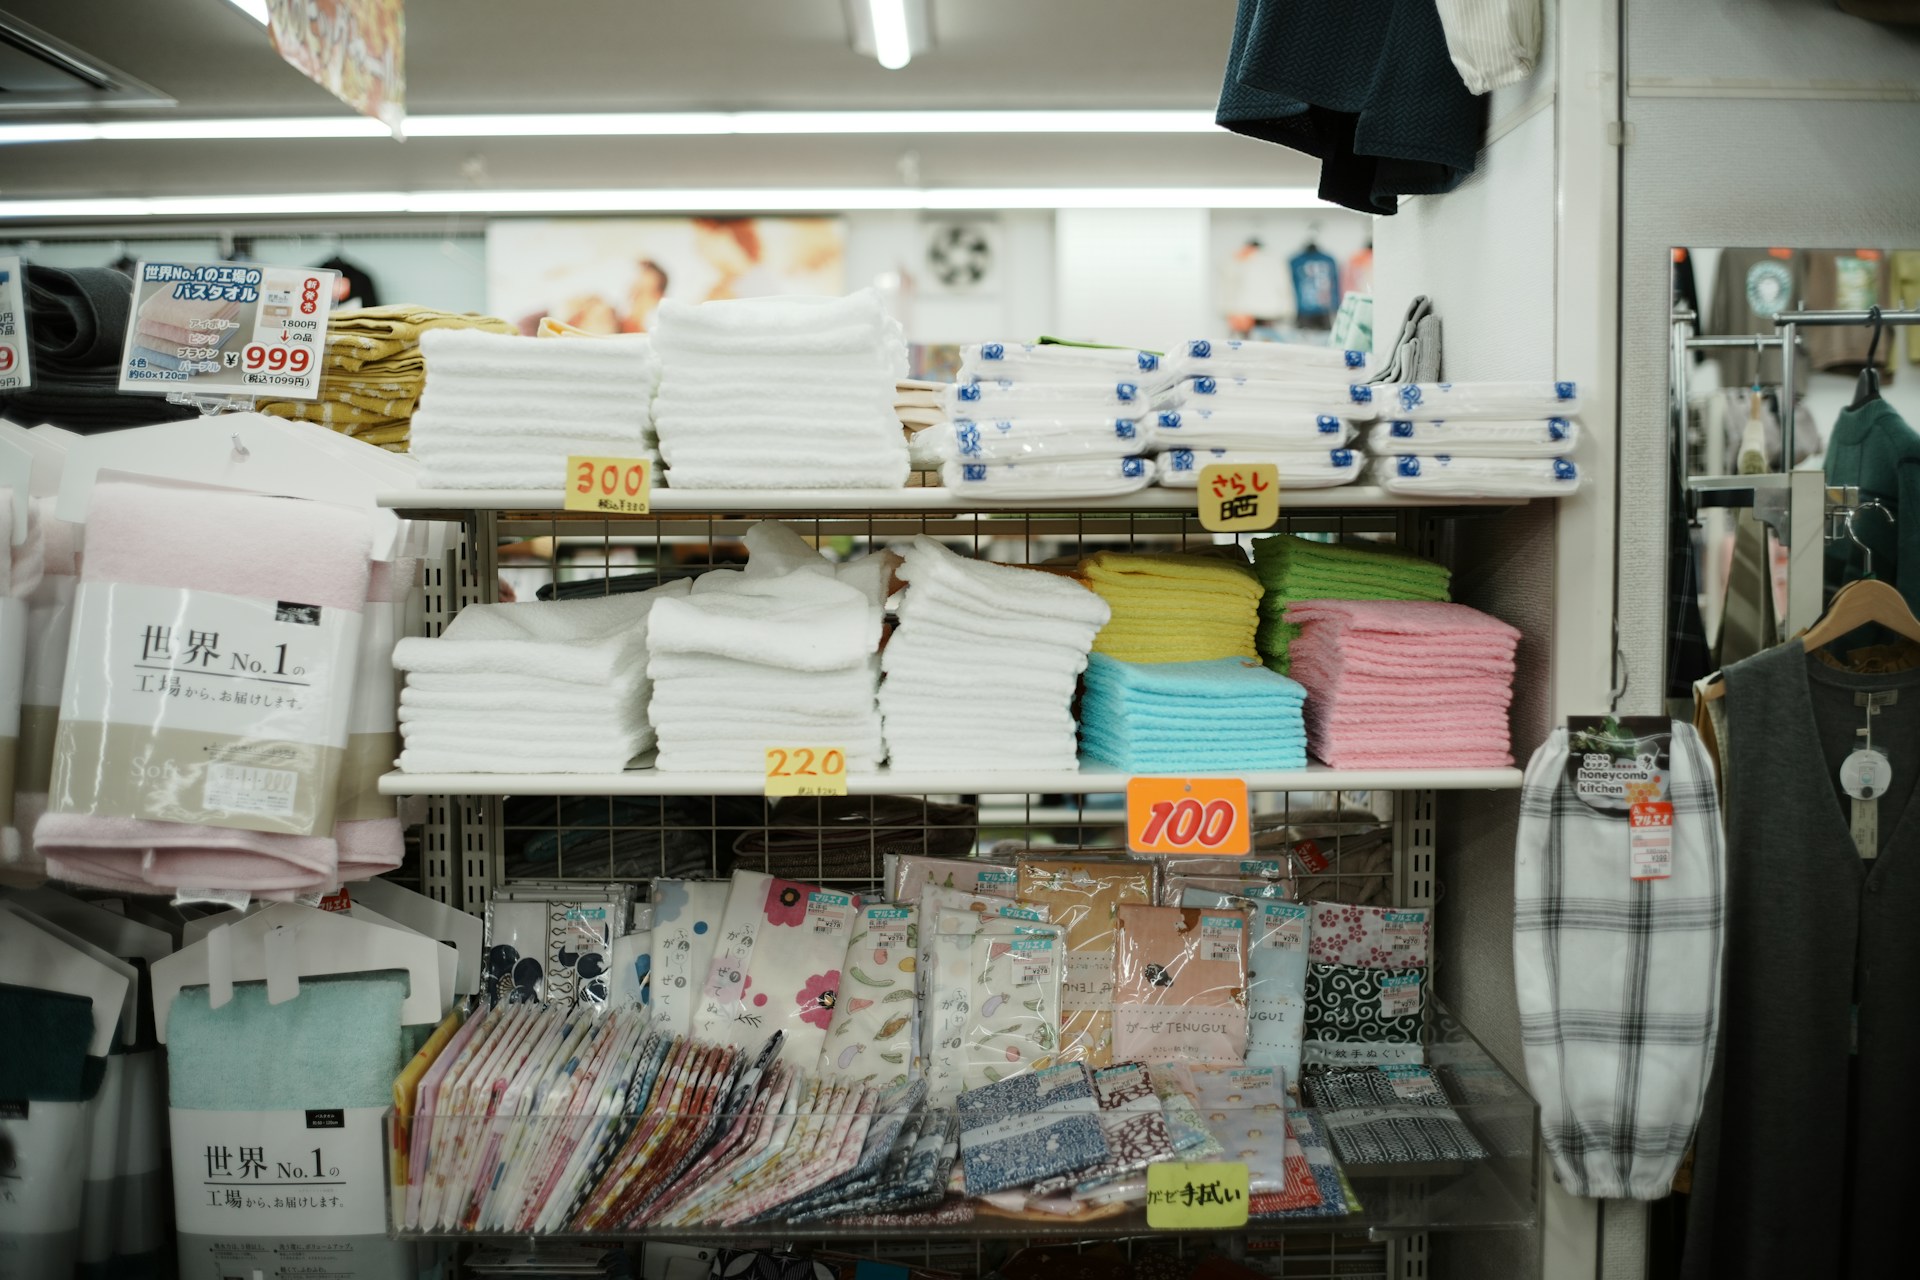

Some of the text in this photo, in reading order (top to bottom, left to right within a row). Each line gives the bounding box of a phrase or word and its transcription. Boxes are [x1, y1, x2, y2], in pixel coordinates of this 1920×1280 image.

[144, 264, 261, 284] 世界No.1の工場の
[173, 283, 258, 302] バスタオル
[302, 279, 320, 314] 新発売
[189, 319, 240, 330] アイボリー
[281, 319, 317, 329] 1800円
[188, 332, 219, 344] ピンク
[292, 332, 313, 342] の品
[177, 348, 219, 359] ブラウン
[224, 345, 309, 373] ¥999
[129, 358, 147, 369] 4色
[178, 359, 221, 372] パープル
[577, 462, 644, 496] 300
[1211, 472, 1269, 498] さらし
[141, 625, 221, 667] 世界
[767, 748, 844, 777] 220
[1579, 769, 1648, 781] honeycomb
[1580, 784, 1623, 793] kitchen
[1140, 798, 1237, 848] 100
[1633, 815, 1670, 825] マルエイ
[814, 894, 843, 904] マルエイ
[1005, 908, 1034, 919] マルエイ
[1391, 914, 1418, 922] マルエイ
[1208, 918, 1237, 928] マルエイ
[1016, 941, 1046, 949] マルエイ
[1388, 976, 1414, 985] マルエイ
[1167, 1022, 1228, 1034] TENUGUI
[203, 1145, 268, 1179] 世界
[206, 1189, 345, 1209] 工場から、お届けします。
